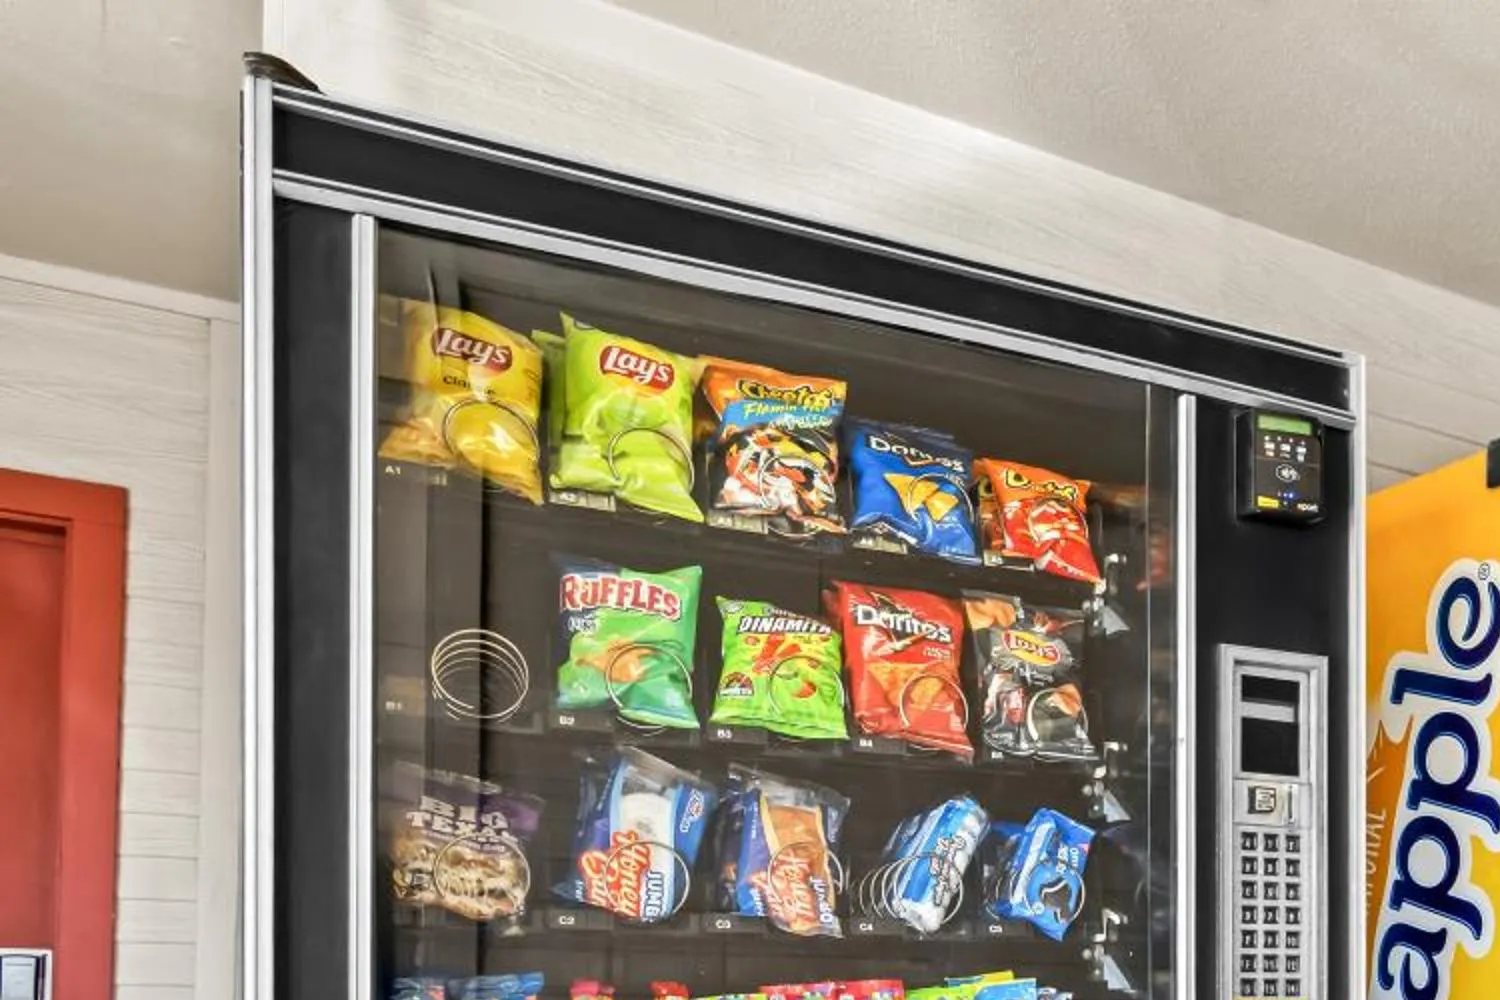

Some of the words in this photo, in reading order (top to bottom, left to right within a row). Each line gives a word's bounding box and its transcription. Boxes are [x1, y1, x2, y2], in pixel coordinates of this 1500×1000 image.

[442, 375, 497, 397] Clac
[602, 346, 672, 386] Lay's
[561, 573, 680, 620] RUFFLES
[857, 604, 953, 642] Doritos
[615, 830, 650, 917] Honey
[644, 871, 666, 921] JUMB
